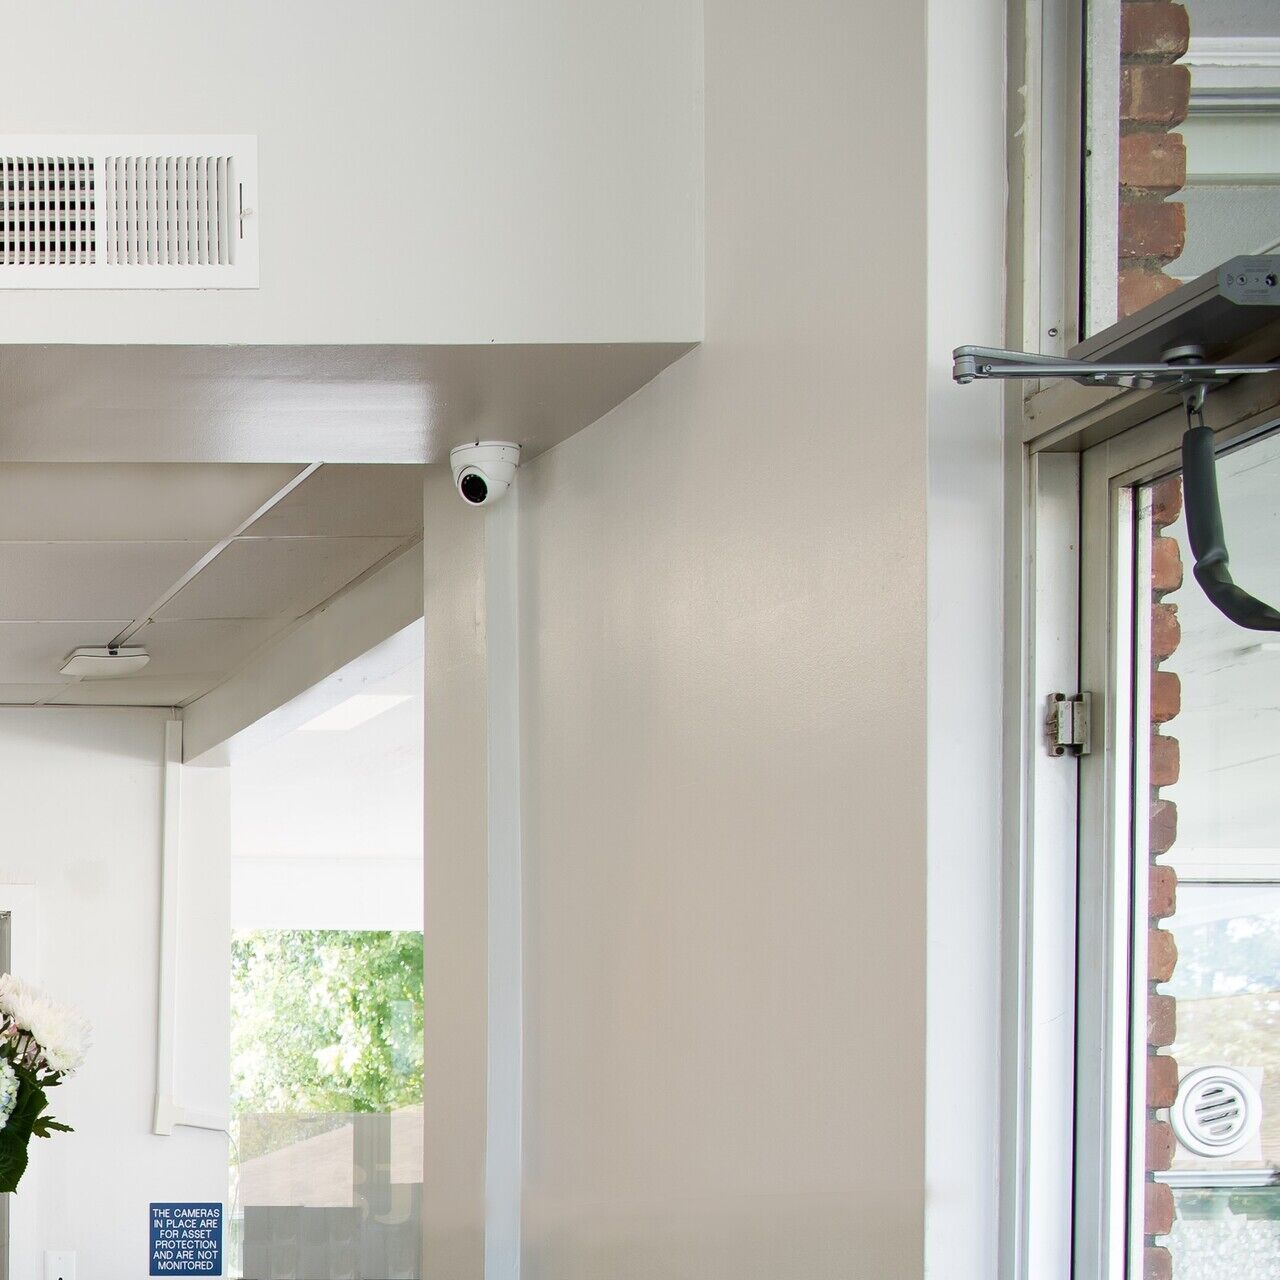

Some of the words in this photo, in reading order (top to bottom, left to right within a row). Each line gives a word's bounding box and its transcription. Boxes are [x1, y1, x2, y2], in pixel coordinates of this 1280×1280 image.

[153, 1209, 170, 1218] THE
[173, 1209, 220, 1218] CAMERAS
[154, 1219, 163, 1228] IN
[166, 1219, 197, 1228] PLACE
[200, 1219, 218, 1228] ARE
[160, 1230, 179, 1238] FOR
[182, 1230, 212, 1238] ASSET
[155, 1240, 217, 1249] PROTECTION
[153, 1251, 173, 1259] AND
[176, 1251, 194, 1259] ARE
[198, 1251, 218, 1259] NOT
[158, 1261, 214, 1270] MONITORED
